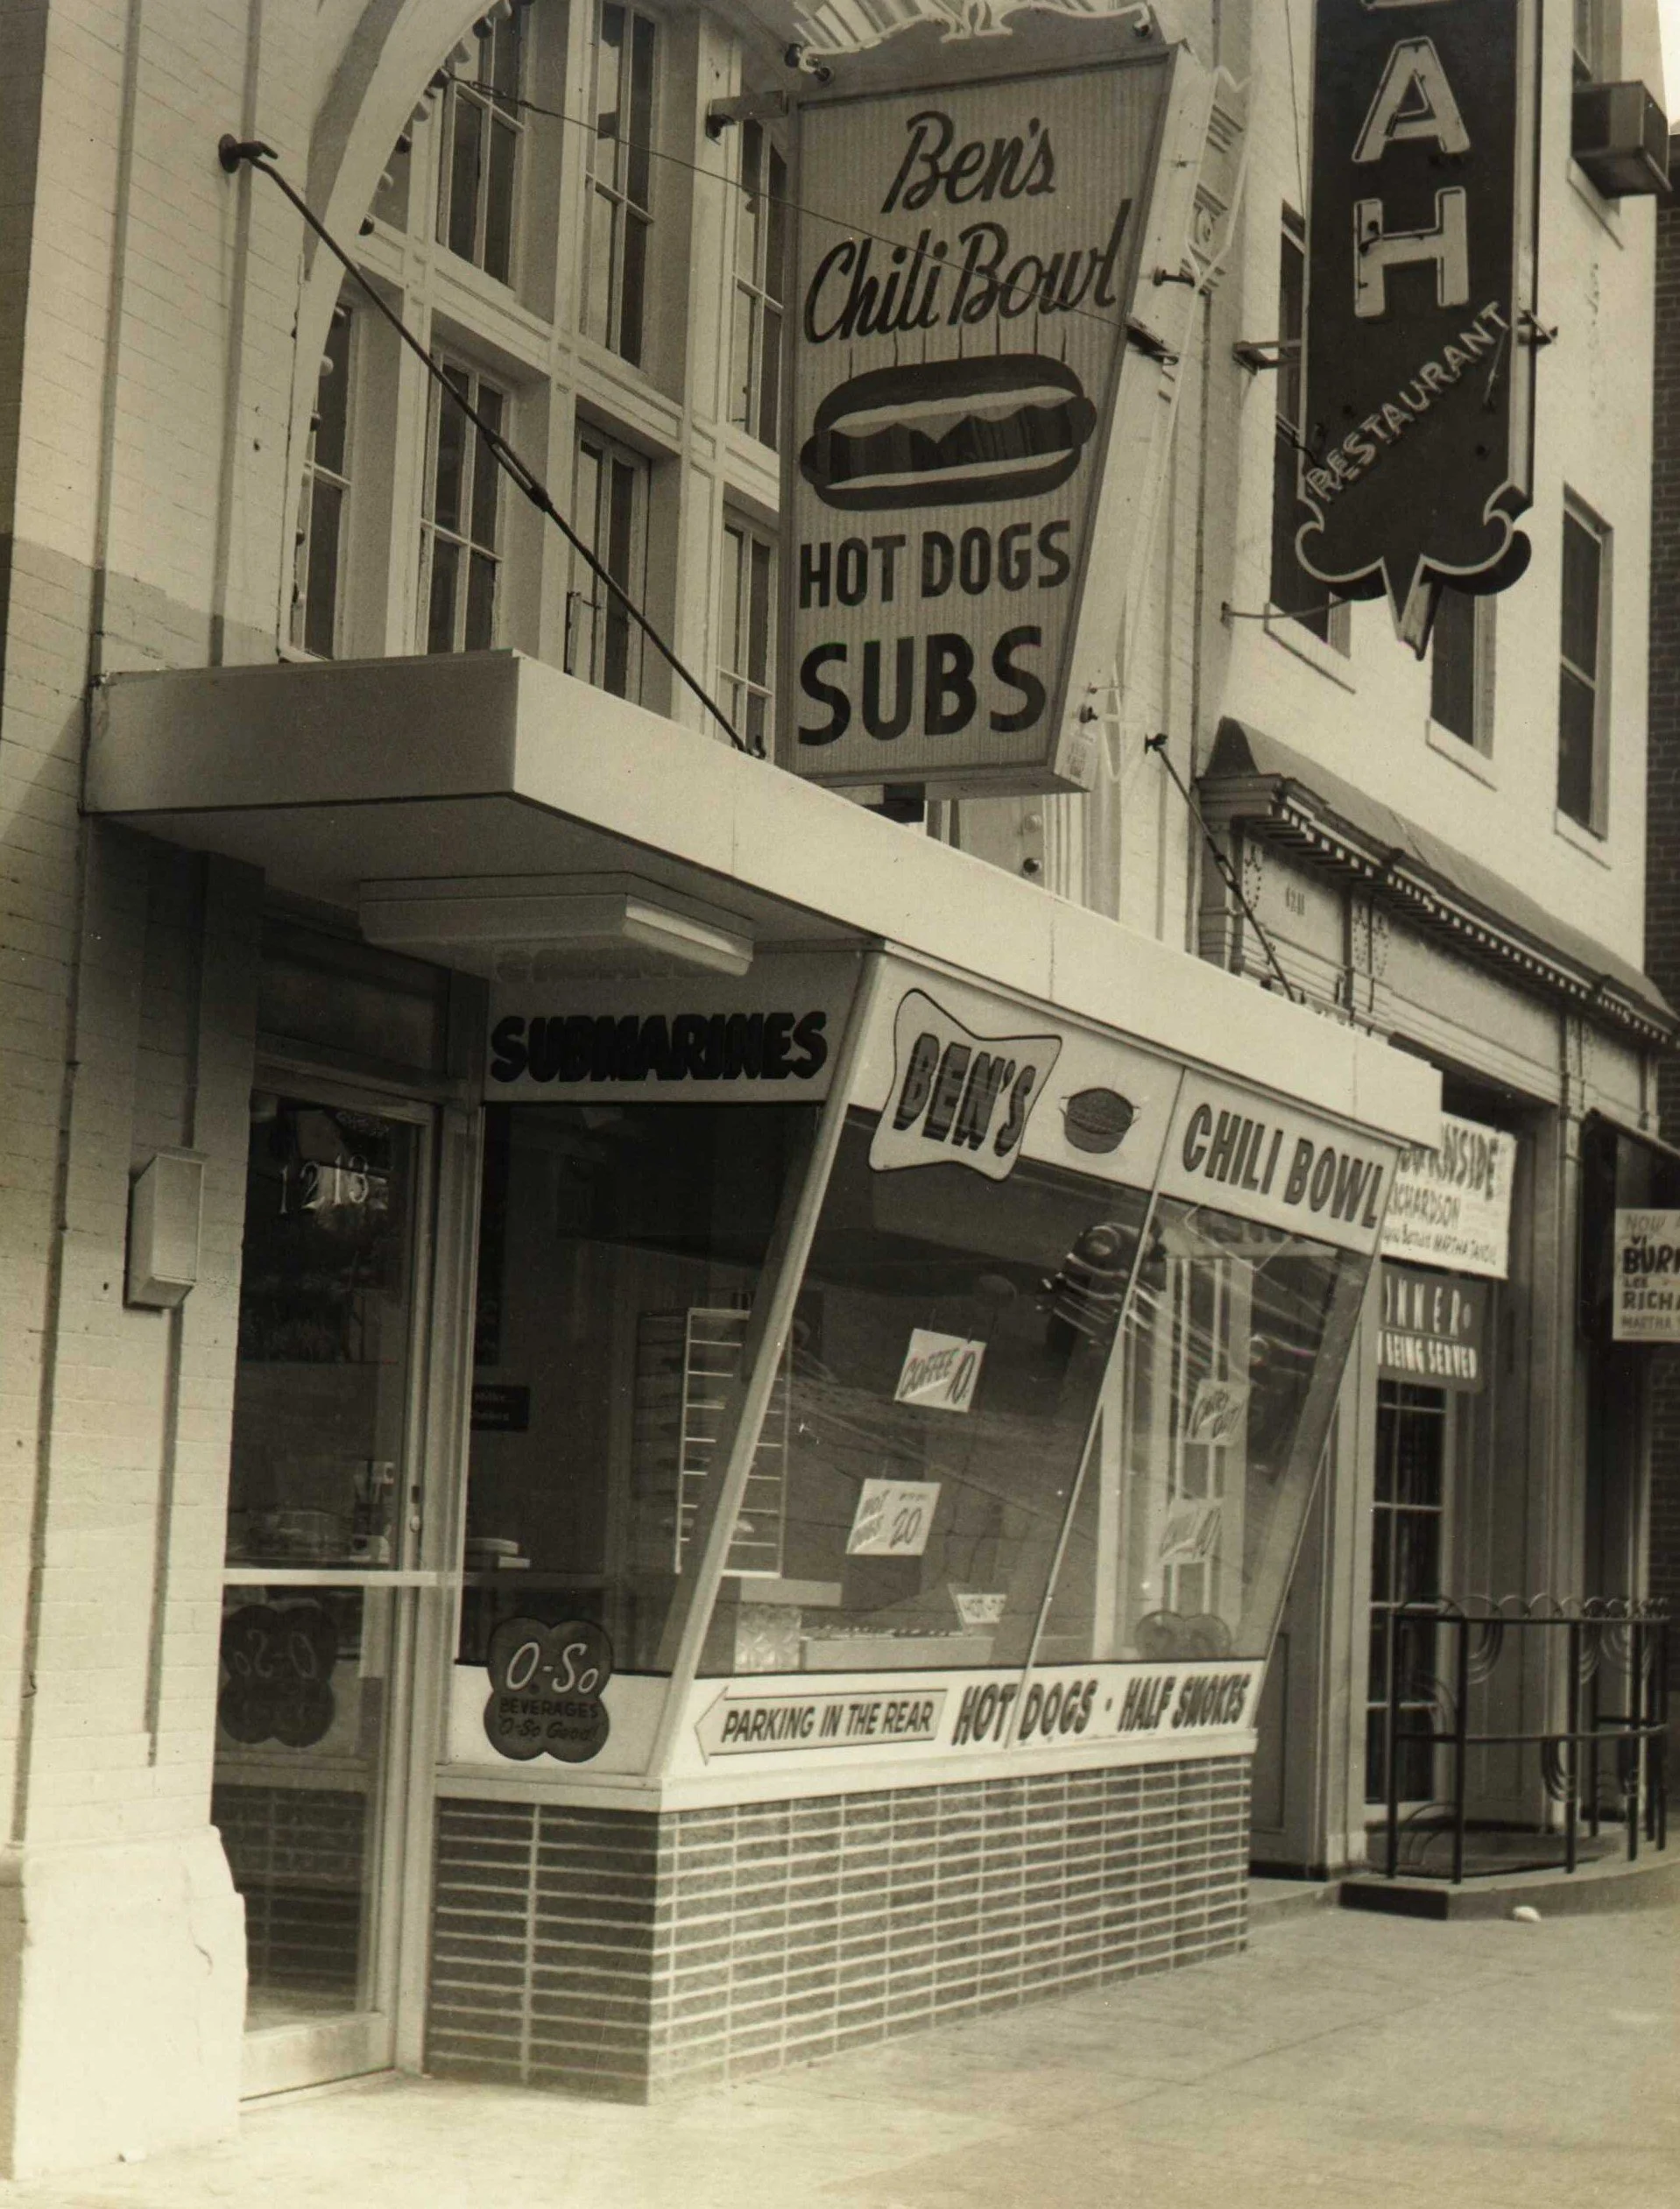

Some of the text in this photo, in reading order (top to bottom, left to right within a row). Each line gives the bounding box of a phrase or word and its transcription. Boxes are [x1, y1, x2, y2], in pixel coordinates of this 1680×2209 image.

[881, 110, 1056, 214] Ben's
[1352, 0, 1471, 318] AH
[803, 199, 1133, 347] Chili Bowl
[1306, 301, 1511, 504] RESTAURANT
[799, 519, 1072, 610] HOT DOGS
[797, 624, 1049, 747] SUBS
[491, 1011, 829, 1083] SUBMARINES
[893, 1032, 1037, 1157] BEN'S
[279, 1154, 370, 1215] 1213
[1181, 1103, 1385, 1230] CHILI BOWL
[499, 1697, 599, 1719] BEVERAGES
[505, 1641, 600, 1695] O-So
[951, 1672, 1253, 1747] HOT DOGS HALF SMOKES
[720, 1700, 935, 1743] PARKING IN THE REAR
